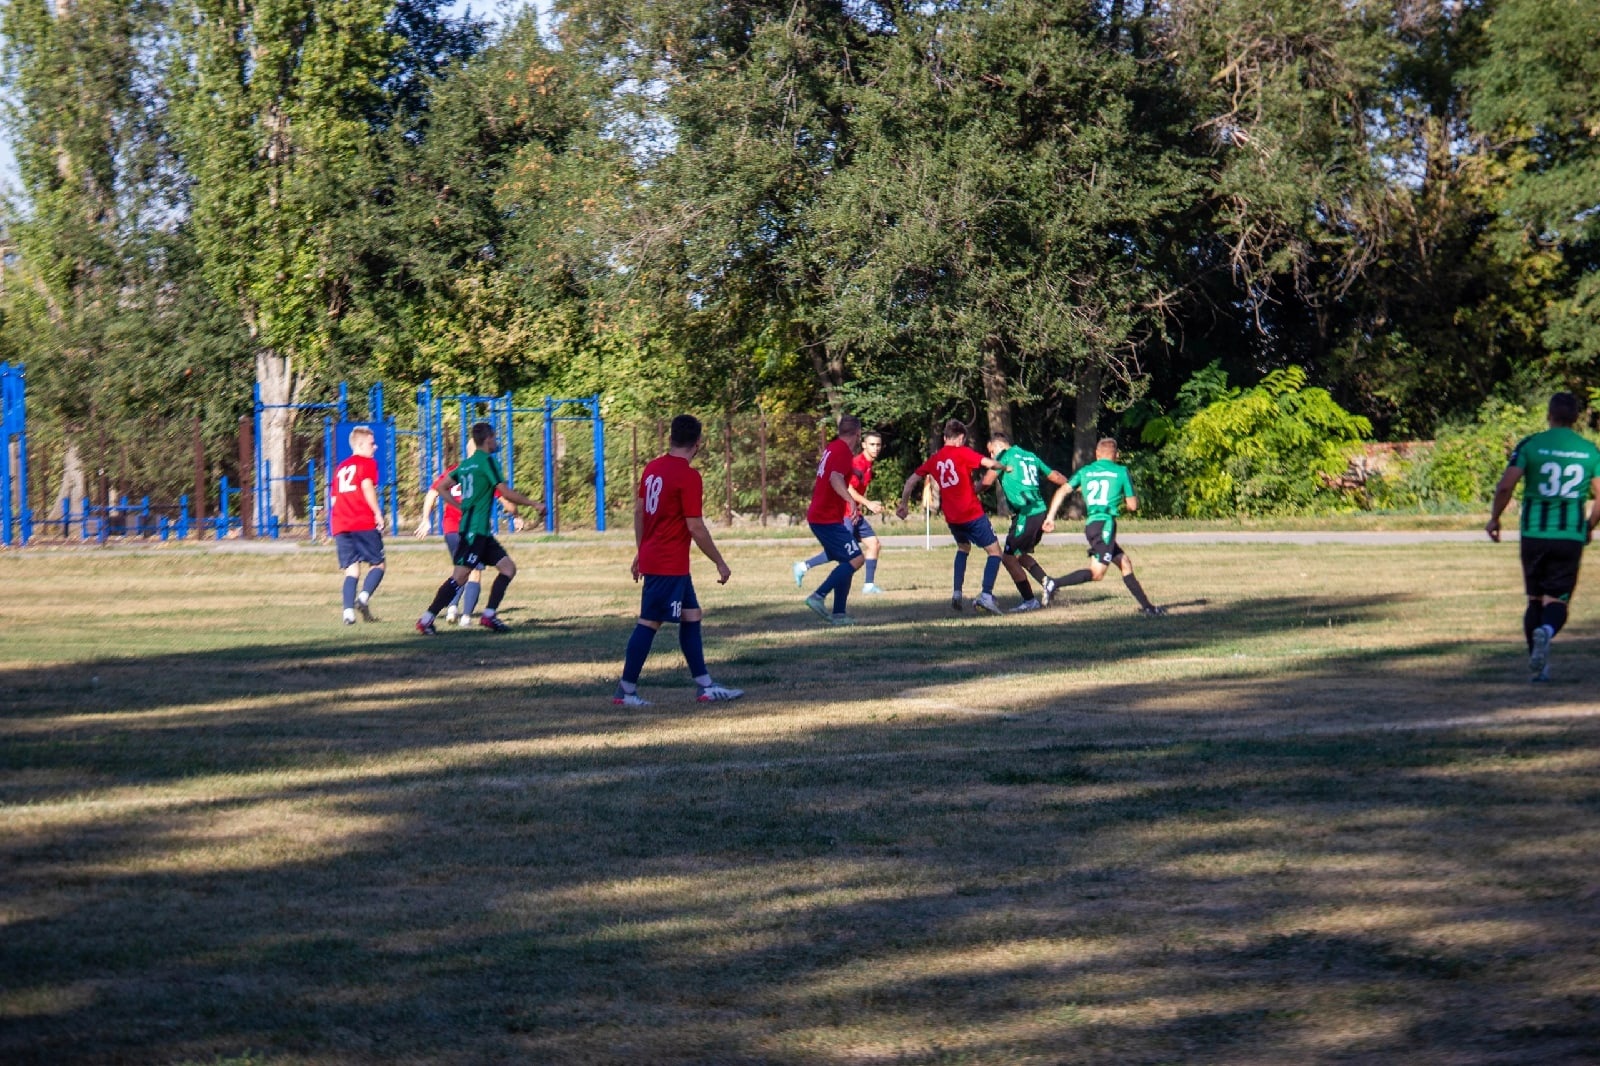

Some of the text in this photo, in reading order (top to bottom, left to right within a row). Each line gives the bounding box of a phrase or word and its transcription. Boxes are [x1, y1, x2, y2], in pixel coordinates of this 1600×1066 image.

[337, 464, 357, 493] 12
[936, 459, 960, 488] 23
[1538, 462, 1585, 498] 32
[645, 474, 663, 515] 18
[1086, 480, 1110, 506] 21
[671, 600, 682, 618] 18
